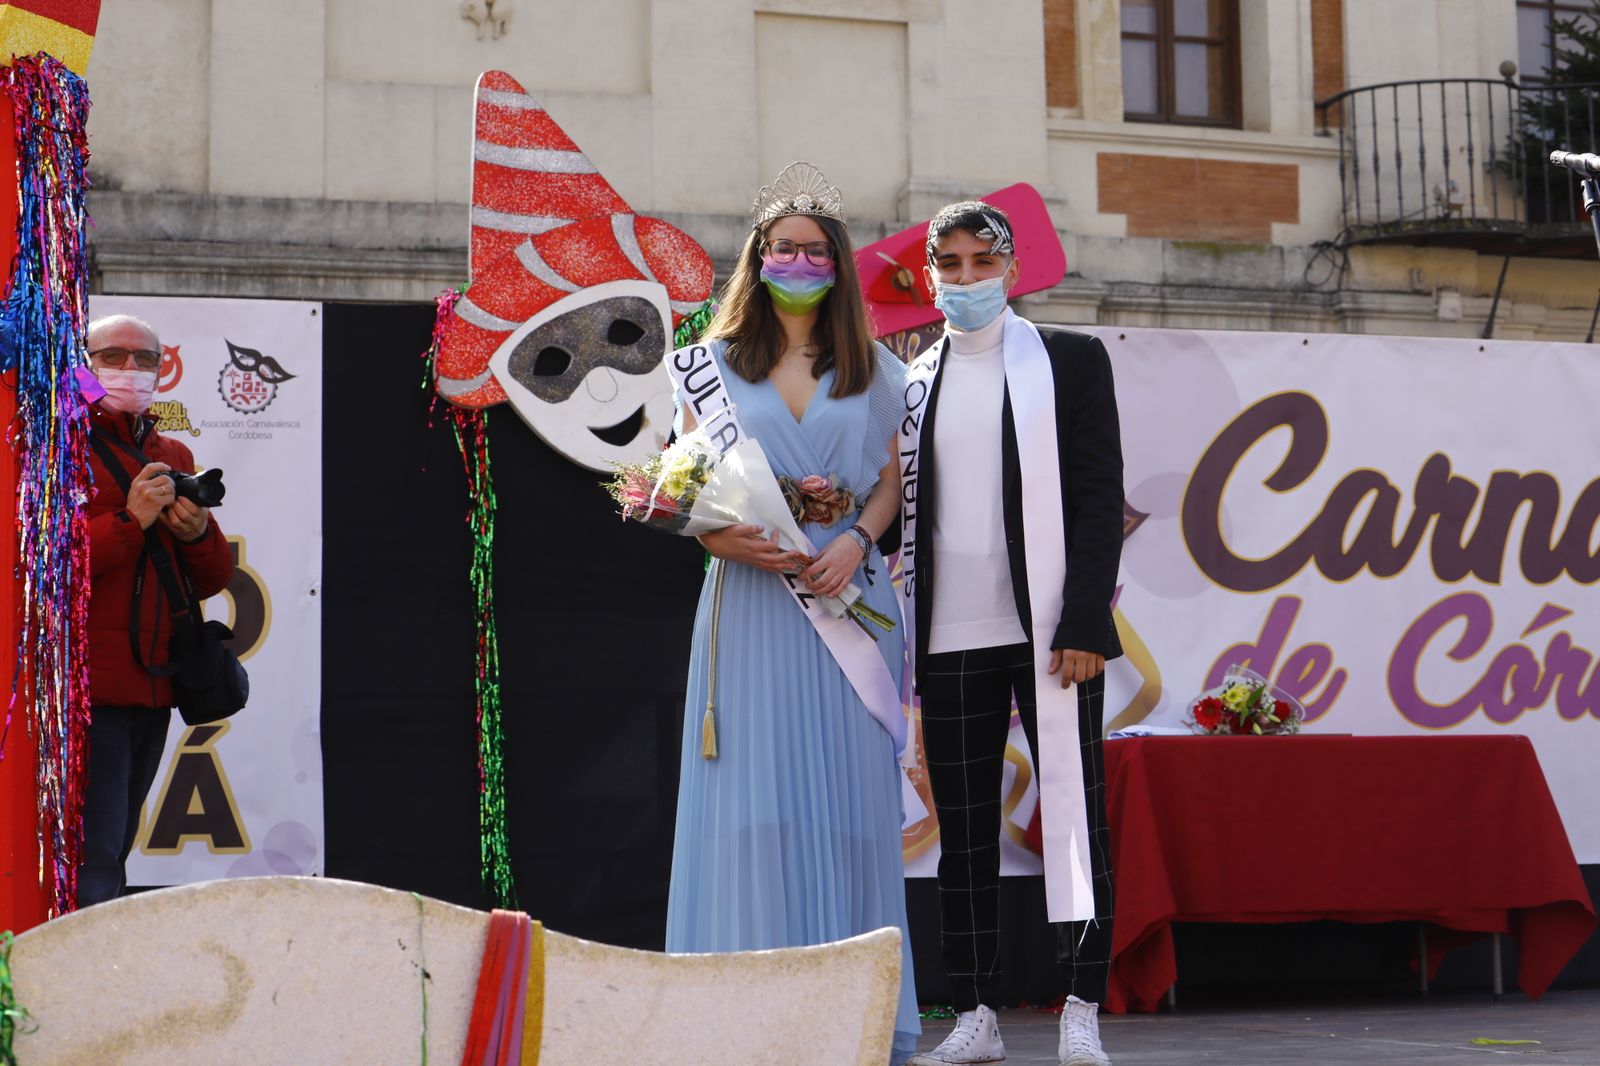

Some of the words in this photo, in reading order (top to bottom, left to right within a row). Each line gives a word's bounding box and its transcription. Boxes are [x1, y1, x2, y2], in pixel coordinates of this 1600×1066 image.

[200, 419, 245, 429] Asociación
[246, 419, 301, 429] Carnavalesca
[673, 345, 739, 455] SULTA
[228, 430, 273, 440] Cordobesa
[1203, 594, 1349, 725] de
[1387, 590, 1600, 730] Cór
